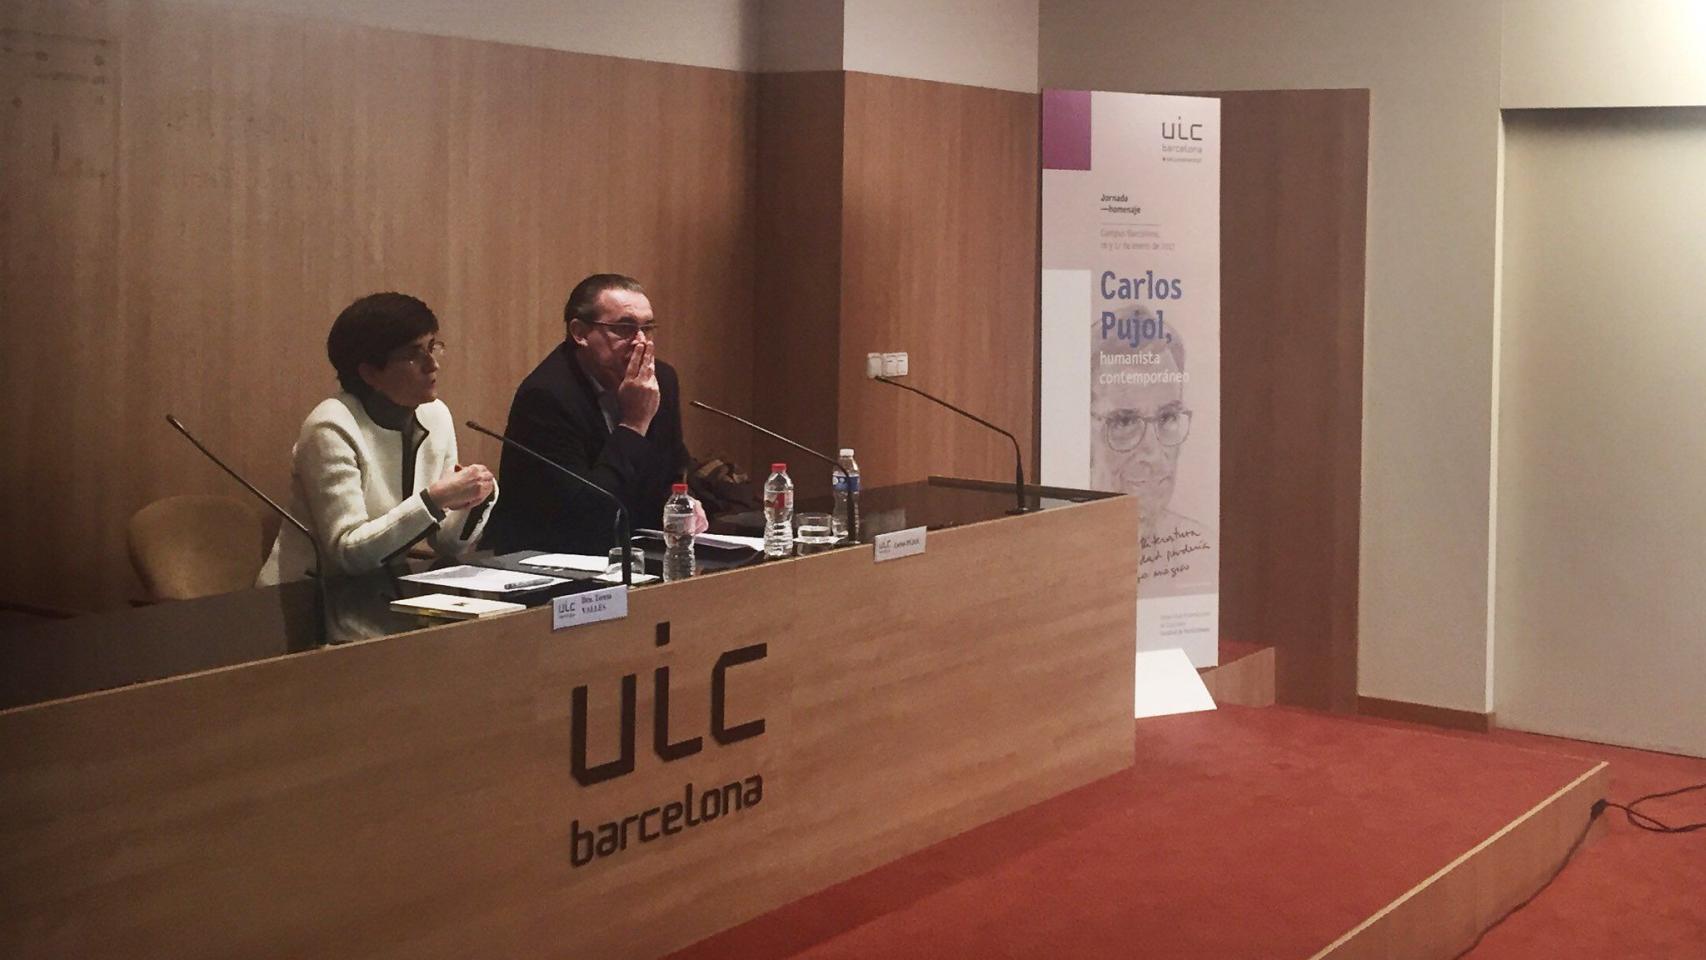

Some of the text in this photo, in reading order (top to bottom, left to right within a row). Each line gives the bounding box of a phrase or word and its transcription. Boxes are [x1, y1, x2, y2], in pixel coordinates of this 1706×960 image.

[1162, 116, 1203, 141] uic
[1100, 193, 1128, 202] Jornada
[1101, 270, 1182, 300] Carlos
[1101, 310, 1172, 348] Pujol,
[1100, 351, 1160, 365] humanista
[1100, 369, 1190, 386] contemporáneo
[571, 774, 763, 868] barcelona
